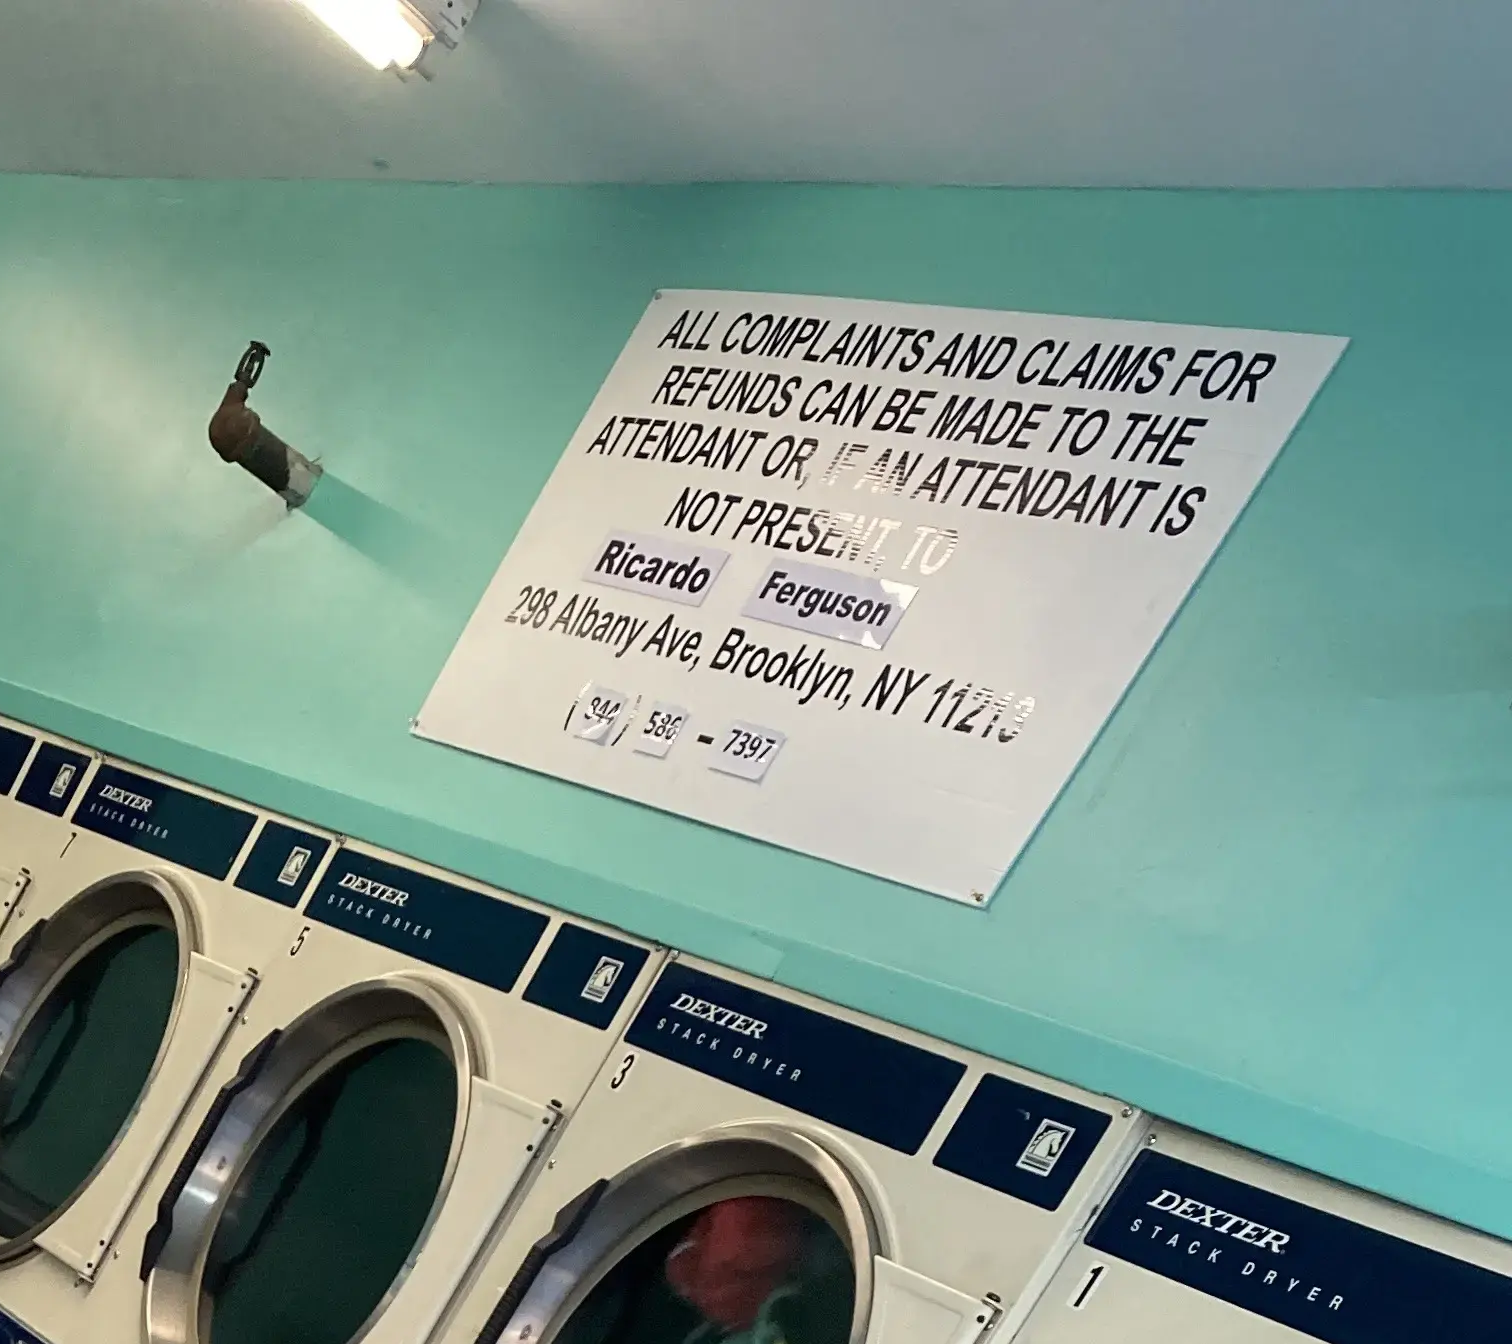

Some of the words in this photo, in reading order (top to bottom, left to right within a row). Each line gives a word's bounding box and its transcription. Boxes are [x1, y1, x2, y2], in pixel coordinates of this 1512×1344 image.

[658, 309, 719, 350] ALL
[720, 312, 935, 373] COMPLAINTS
[924, 332, 1018, 380] AND
[1016, 339, 1176, 394] CLAIMS
[1169, 349, 1277, 402] FOR
[651, 365, 802, 418] REFUNDS
[799, 379, 882, 428] CAN
[872, 388, 938, 434] BE
[927, 394, 1053, 449] MADE
[1047, 406, 1110, 456] TO
[1111, 412, 1208, 467] THE
[587, 415, 769, 473] ATTENDANT
[761, 434, 820, 490] OR,
[819, 442, 870, 487] IF
[854, 448, 924, 497] AN
[910, 456, 1161, 530] ATTENDANT
[1149, 484, 1208, 537] IS
[664, 486, 744, 538] NOT
[899, 525, 960, 576] TO
[594, 540, 711, 593] Ricardo
[758, 570, 892, 627] Ferguson
[504, 585, 559, 629] 298
[549, 593, 648, 658] Albany
[641, 613, 703, 672] Ave,
[709, 627, 854, 710] Brooklyn,
[861, 663, 932, 716] NY
[643, 709, 683, 743] 586
[722, 728, 778, 763] 7397
[89, 803, 125, 823] STACK
[130, 818, 169, 839] DRYER
[98, 784, 153, 812] DEXTER
[60, 832, 77, 859] 7
[327, 893, 376, 919] STACK
[381, 913, 433, 940] DRYER
[338, 872, 409, 907] DEXTER
[290, 926, 311, 957] 5
[670, 993, 768, 1040] DEXTER
[610, 1054, 636, 1090] 3
[657, 1017, 721, 1050] STACK
[732, 1047, 802, 1082] DRYER
[1146, 1189, 1291, 1254] DEXTER
[1073, 1265, 1105, 1308] 1
[1130, 1218, 1222, 1263] STACK
[1241, 1261, 1344, 1310] DRYER
